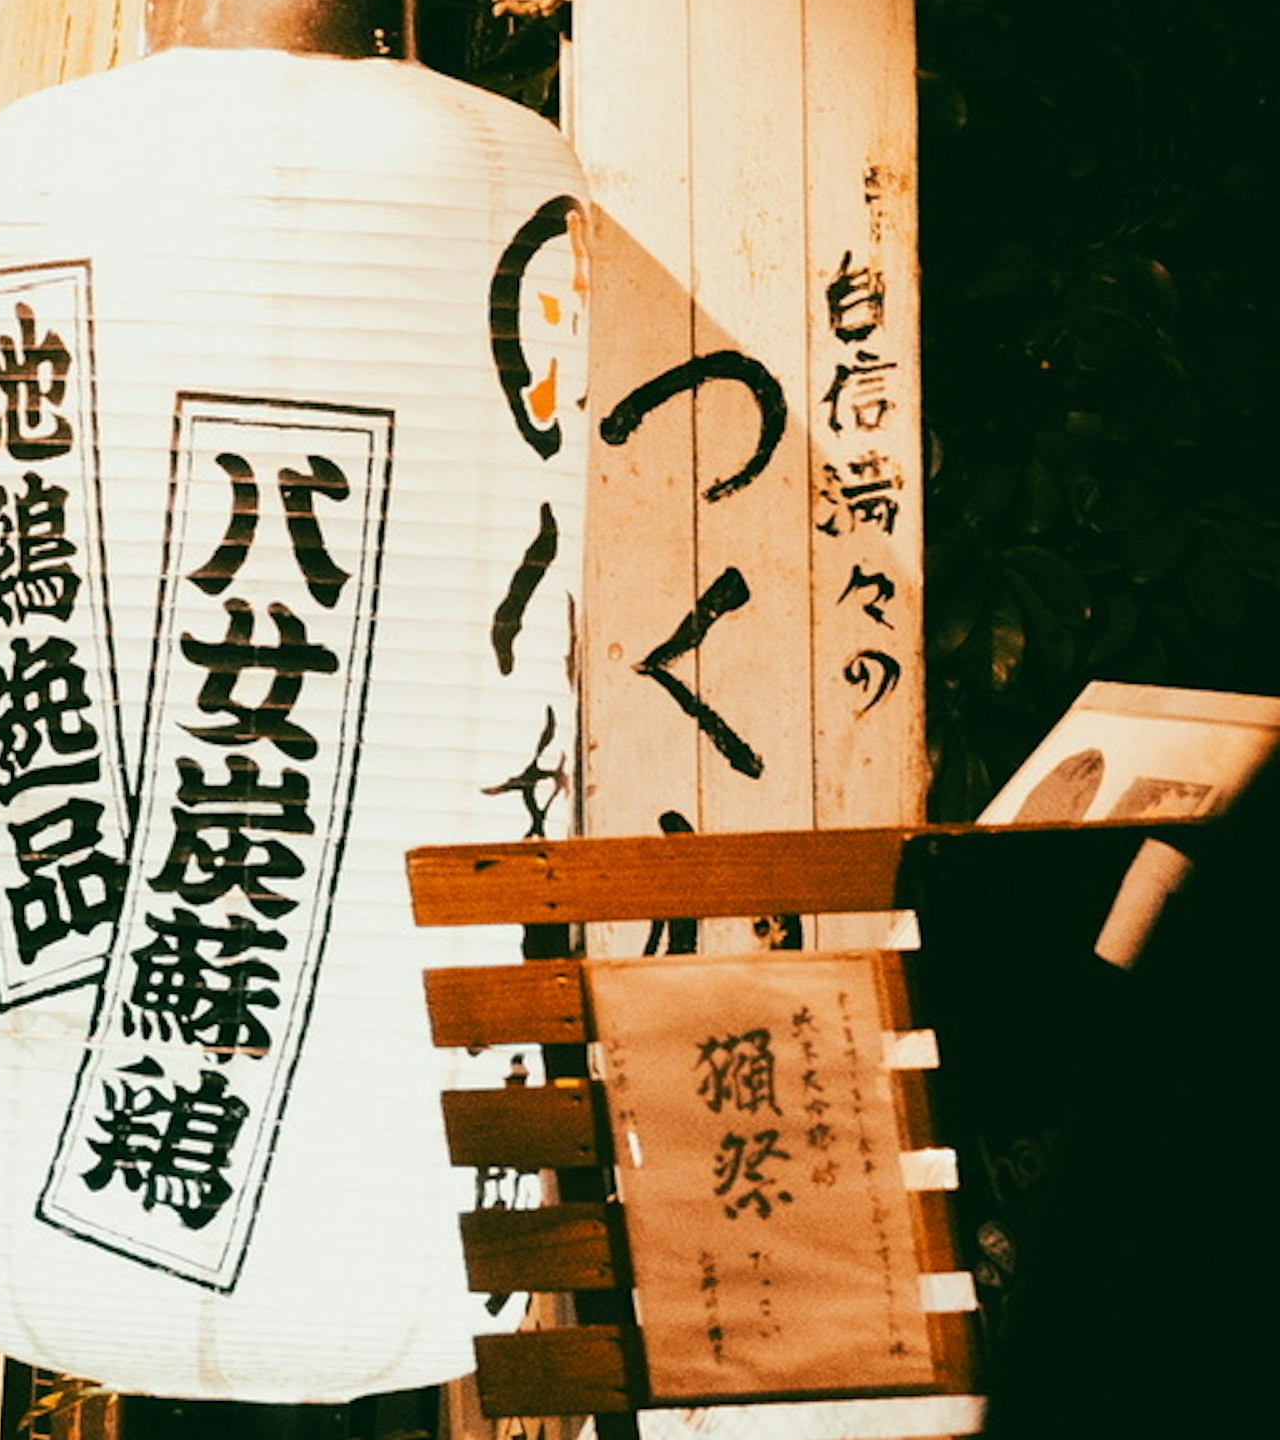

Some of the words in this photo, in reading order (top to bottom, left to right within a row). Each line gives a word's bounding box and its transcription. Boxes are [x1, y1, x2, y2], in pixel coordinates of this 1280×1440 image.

[599, 348, 788, 782] つく
[817, 250, 904, 721] 自信満々の
